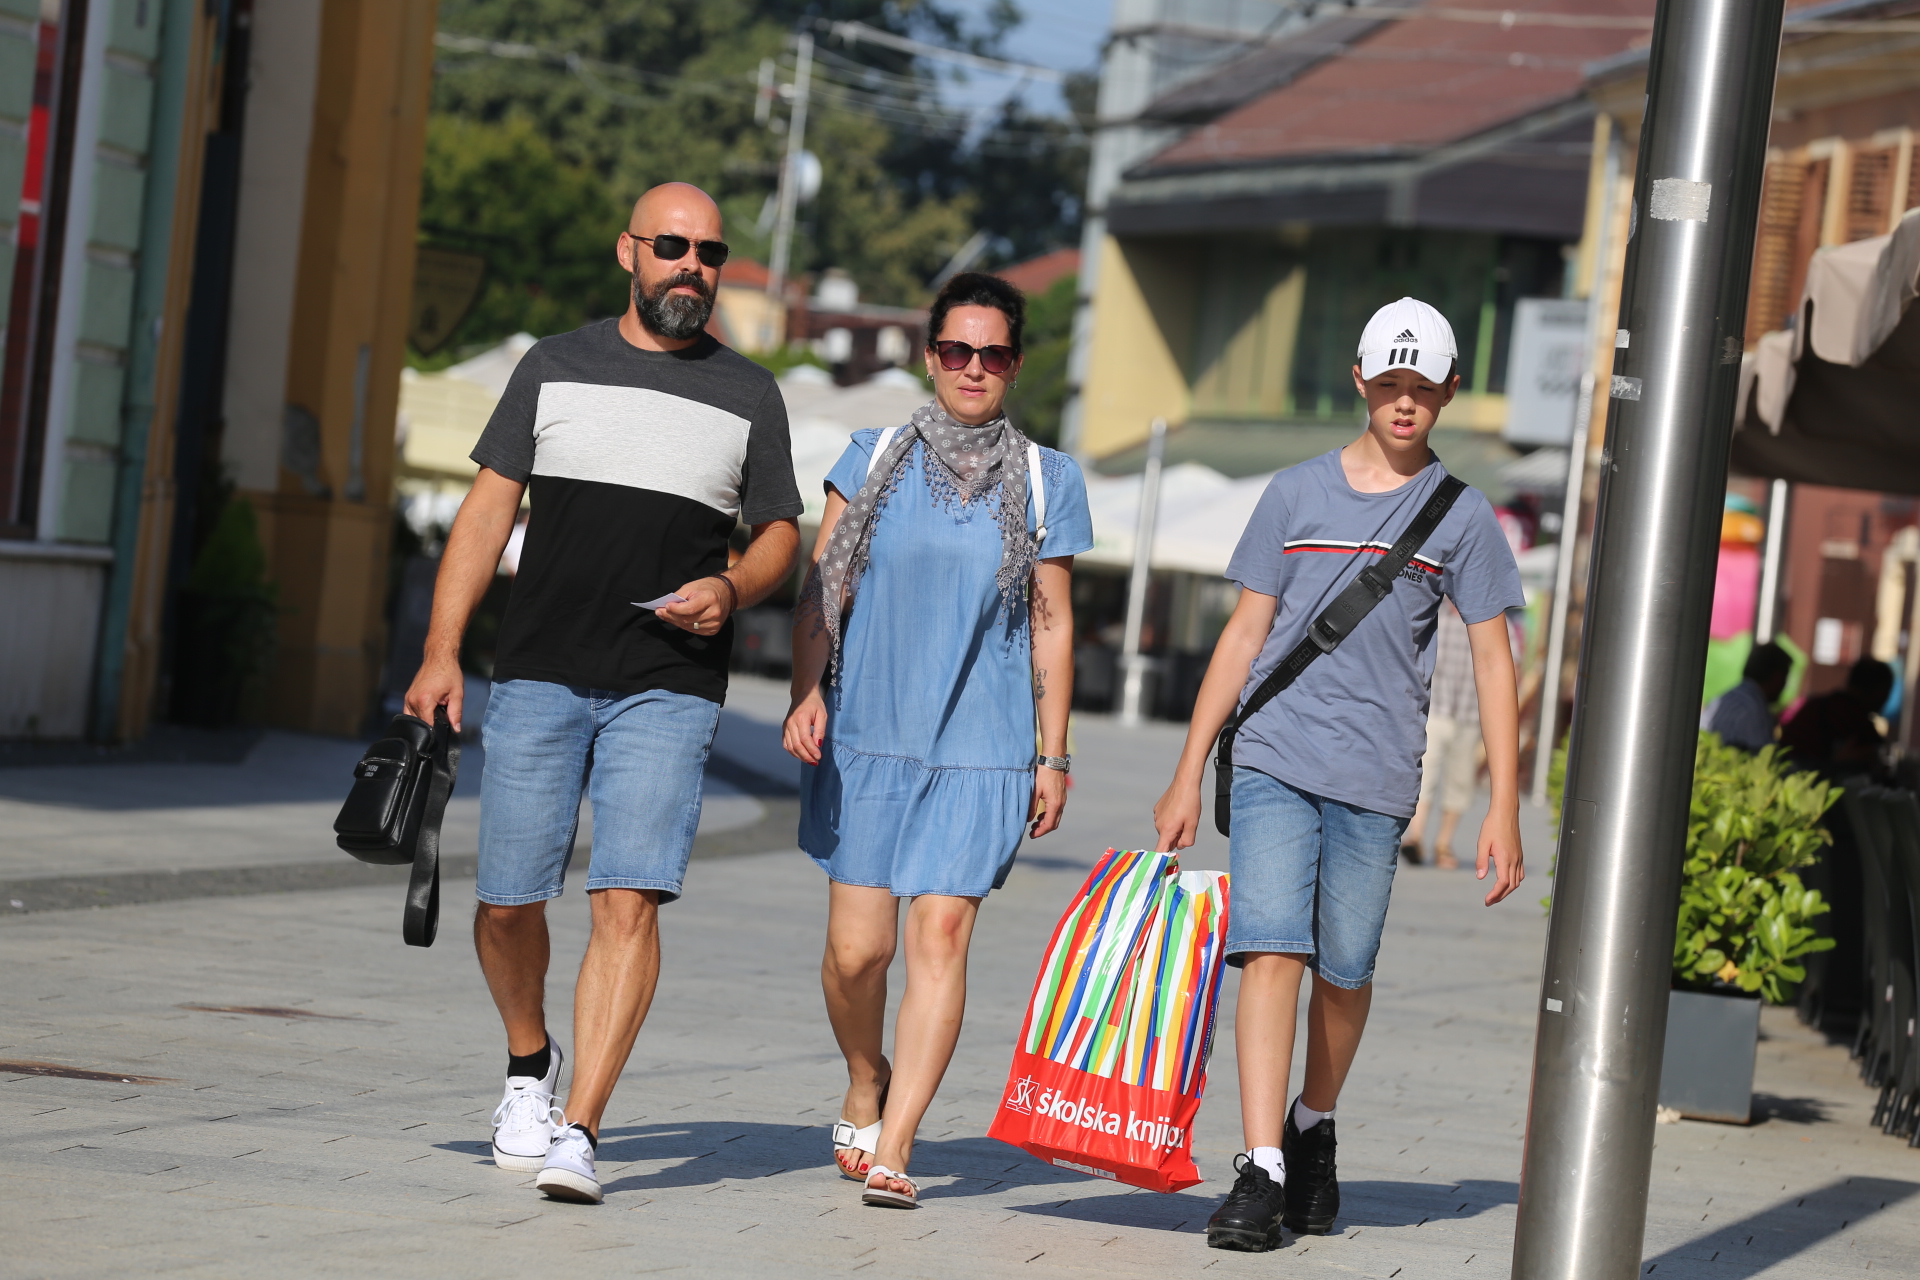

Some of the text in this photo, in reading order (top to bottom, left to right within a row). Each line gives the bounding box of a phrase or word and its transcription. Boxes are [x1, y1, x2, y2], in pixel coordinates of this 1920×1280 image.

[1427, 496, 1447, 519] GUCCI
[1397, 568, 1424, 584] ONES
[1289, 647, 1312, 670] GUCCI
[1035, 1087, 1121, 1135] školska
